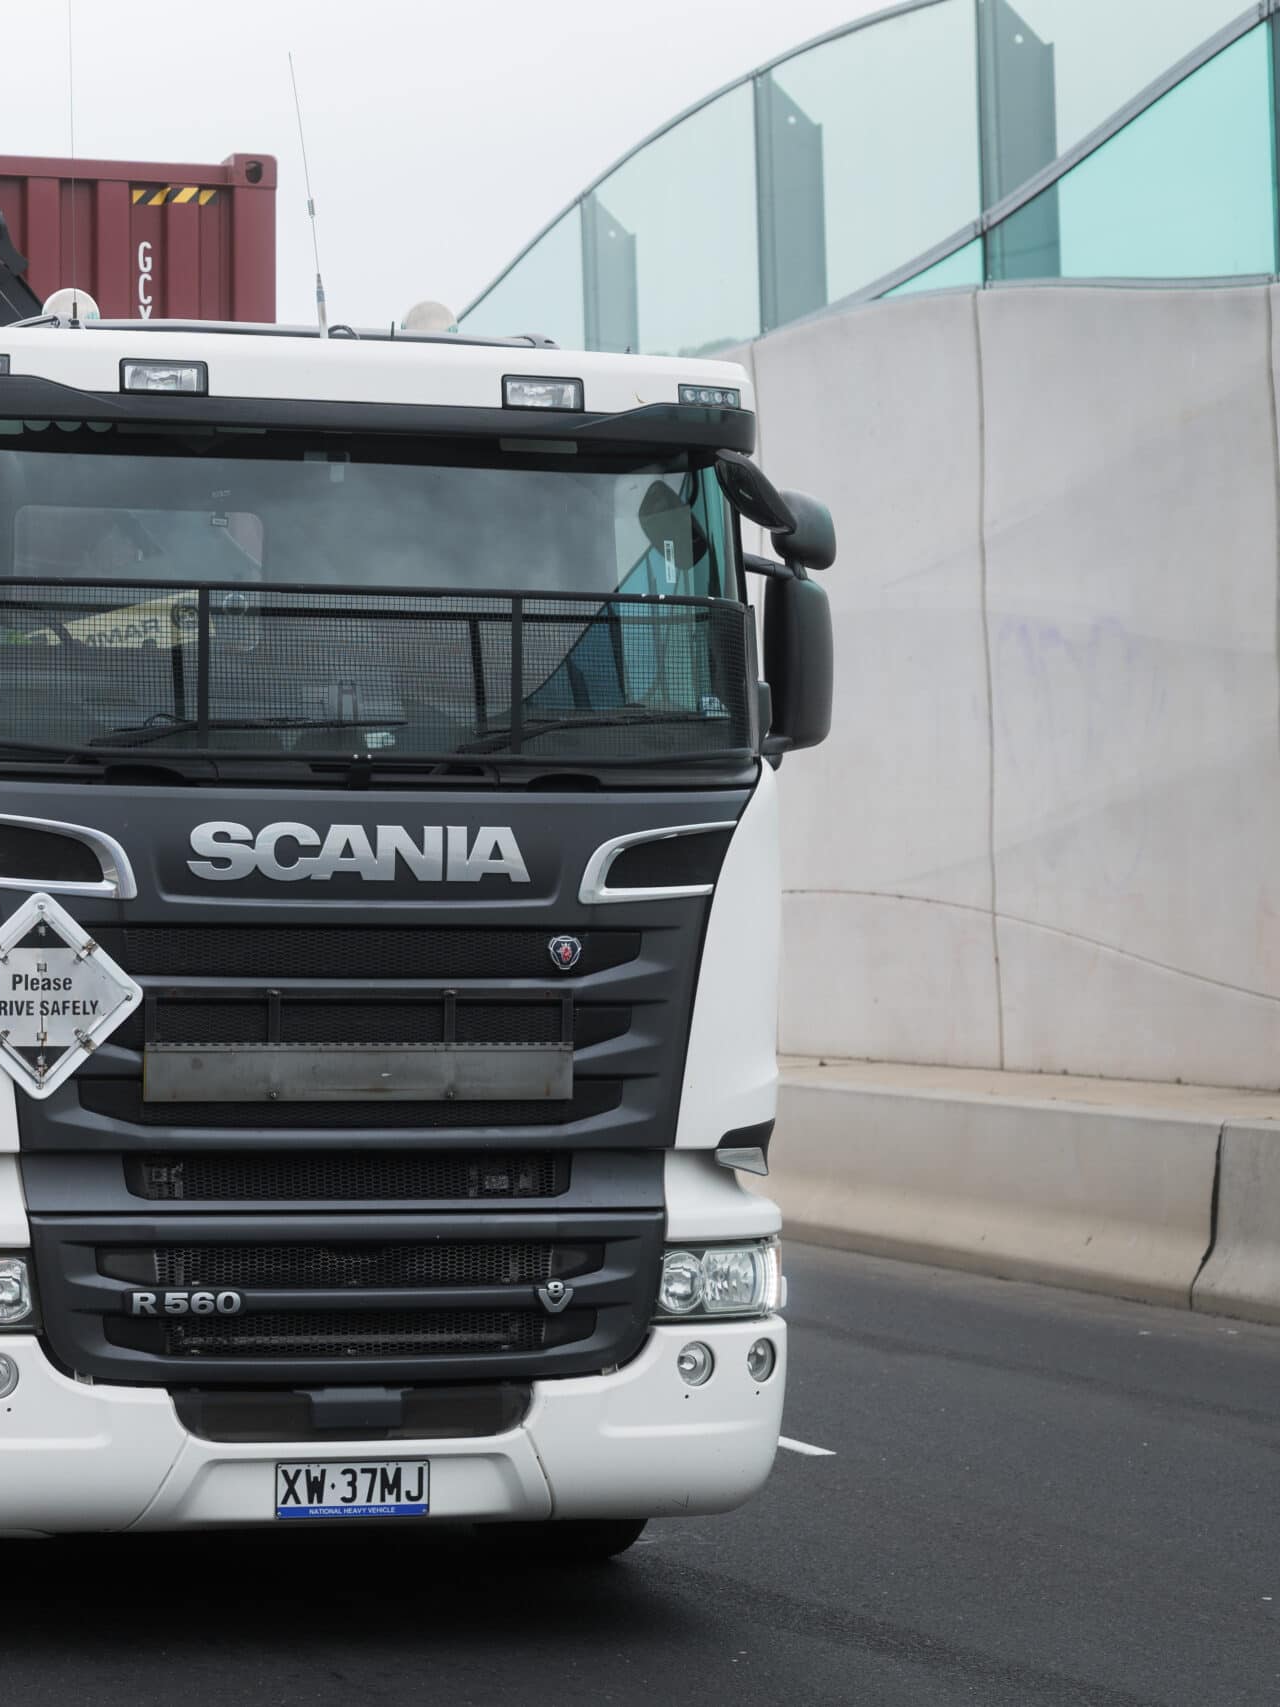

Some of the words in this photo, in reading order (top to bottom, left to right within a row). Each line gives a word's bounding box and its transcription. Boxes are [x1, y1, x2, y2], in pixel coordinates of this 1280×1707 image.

[186, 821, 531, 883] SCANIA
[12, 973, 73, 991] Please
[39, 1000, 99, 1016] SAFELY
[132, 1292, 158, 1314] R
[164, 1291, 241, 1314] 560
